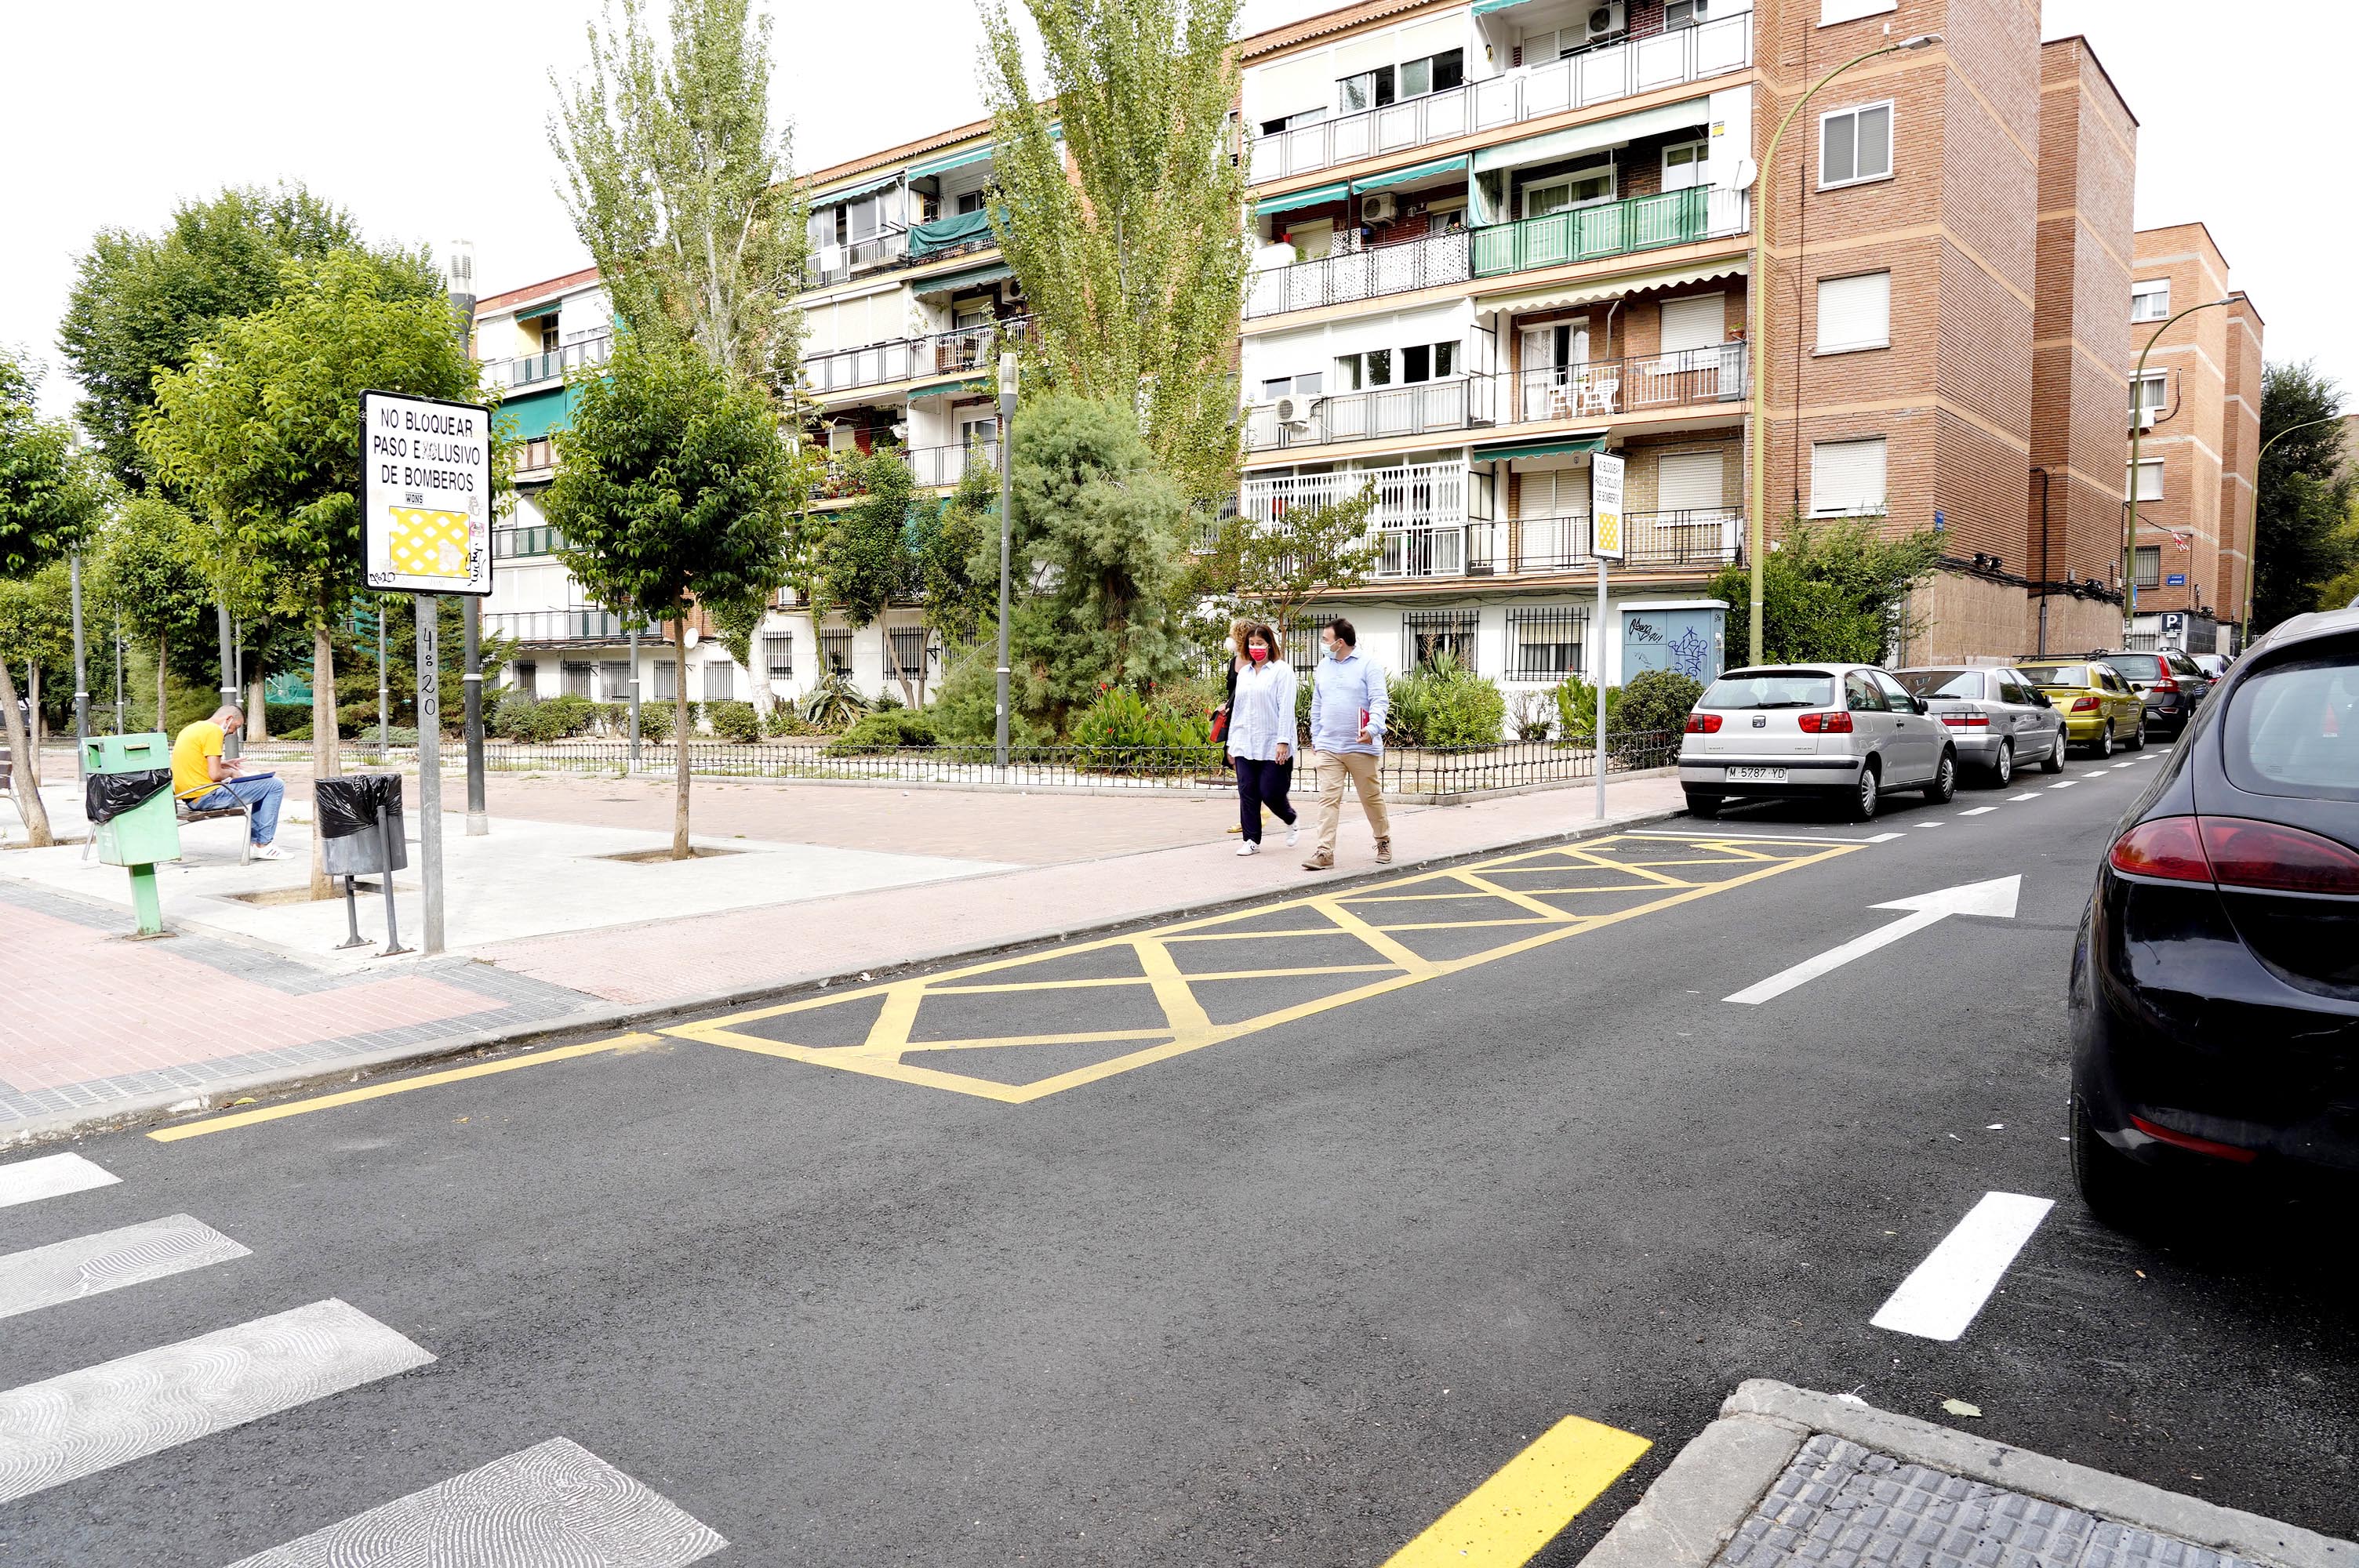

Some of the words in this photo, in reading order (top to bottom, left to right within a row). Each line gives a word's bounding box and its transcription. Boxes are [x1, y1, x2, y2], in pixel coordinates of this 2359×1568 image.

[381, 408, 399, 429] NO
[405, 410, 473, 438] BLOQUEAR
[373, 436, 407, 458] PASO
[413, 440, 481, 466] EXCLUSIVO
[381, 464, 398, 485] DE
[405, 466, 474, 492] BOMBEROS
[2166, 615, 2178, 628] P
[1729, 768, 1736, 777] M
[1741, 768, 1766, 778] 5787
[1772, 768, 1785, 779] YD
